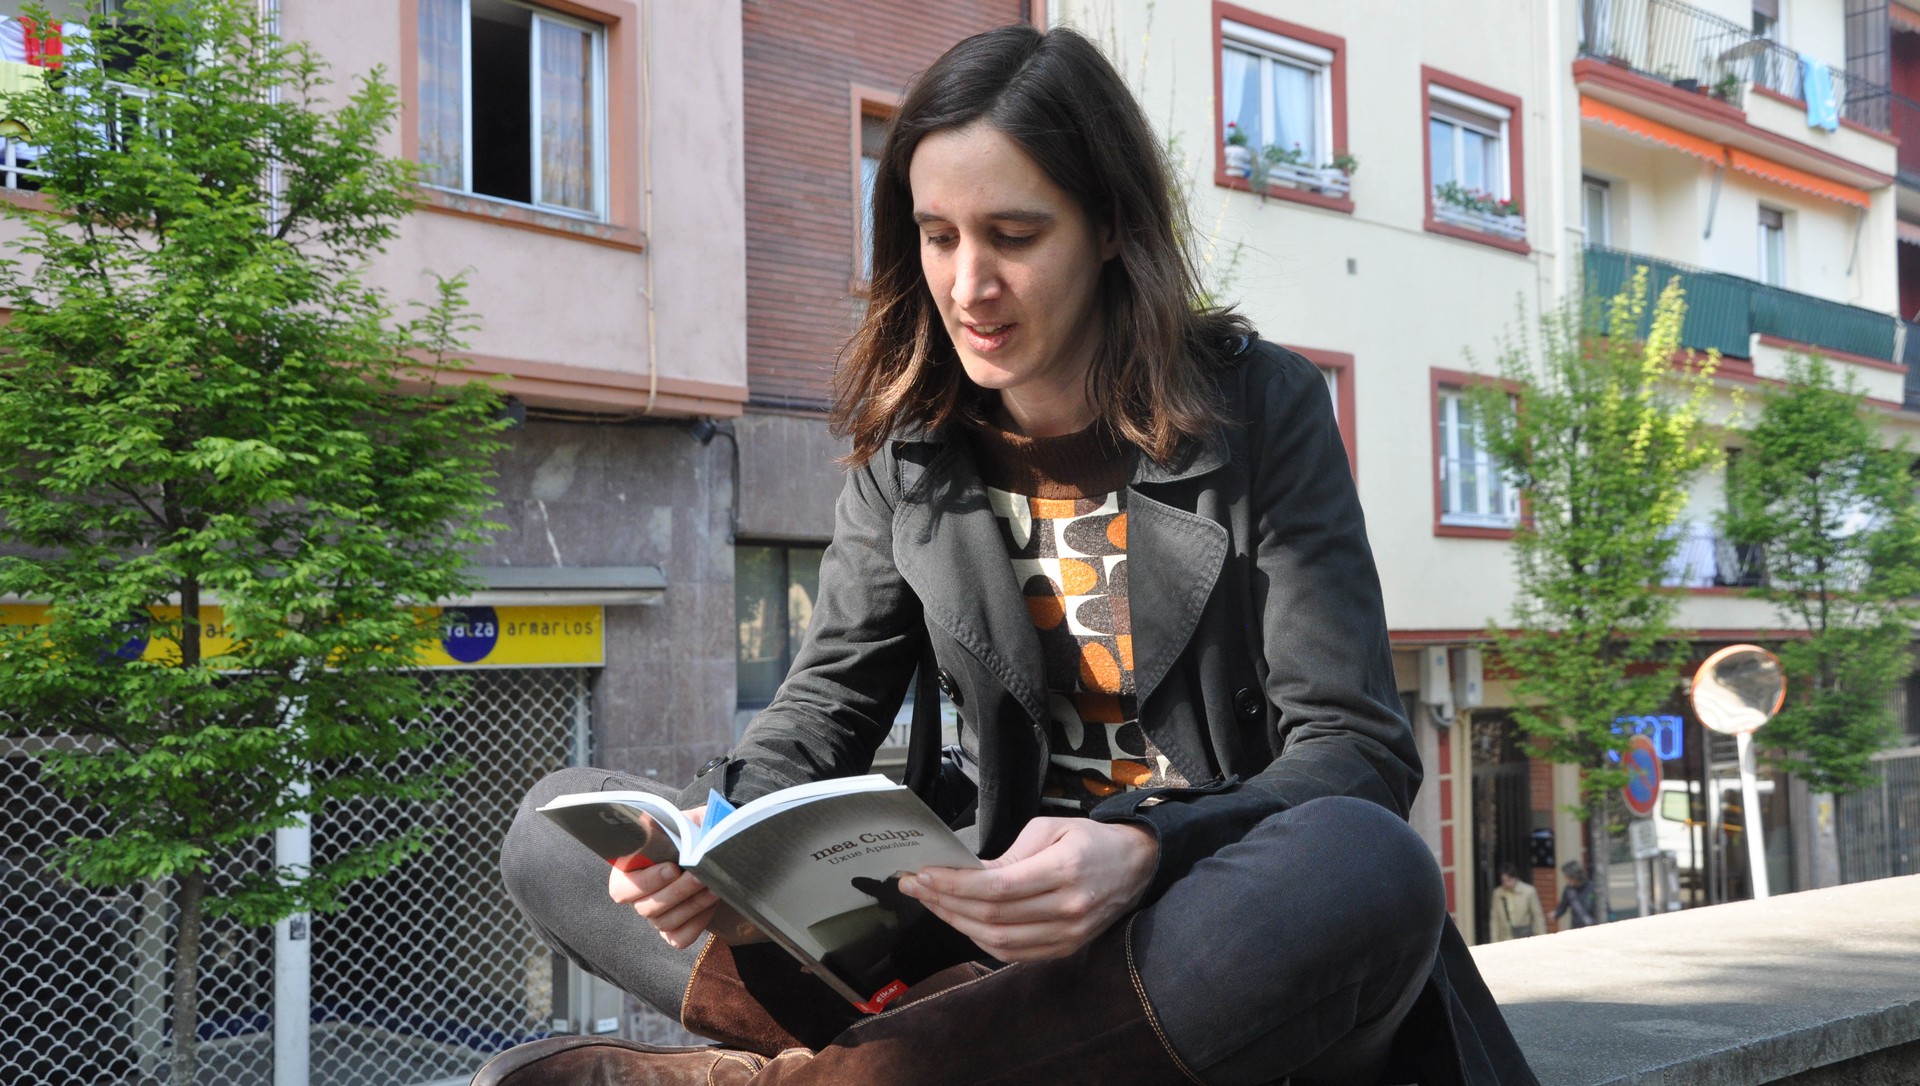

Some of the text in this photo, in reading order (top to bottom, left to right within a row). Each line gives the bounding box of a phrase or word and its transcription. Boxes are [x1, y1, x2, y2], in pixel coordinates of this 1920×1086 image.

[507, 621, 593, 636] armarios
[810, 829, 924, 861] mea Culpa
[828, 850, 863, 865] Uxue
[876, 984, 898, 1004] elkar
